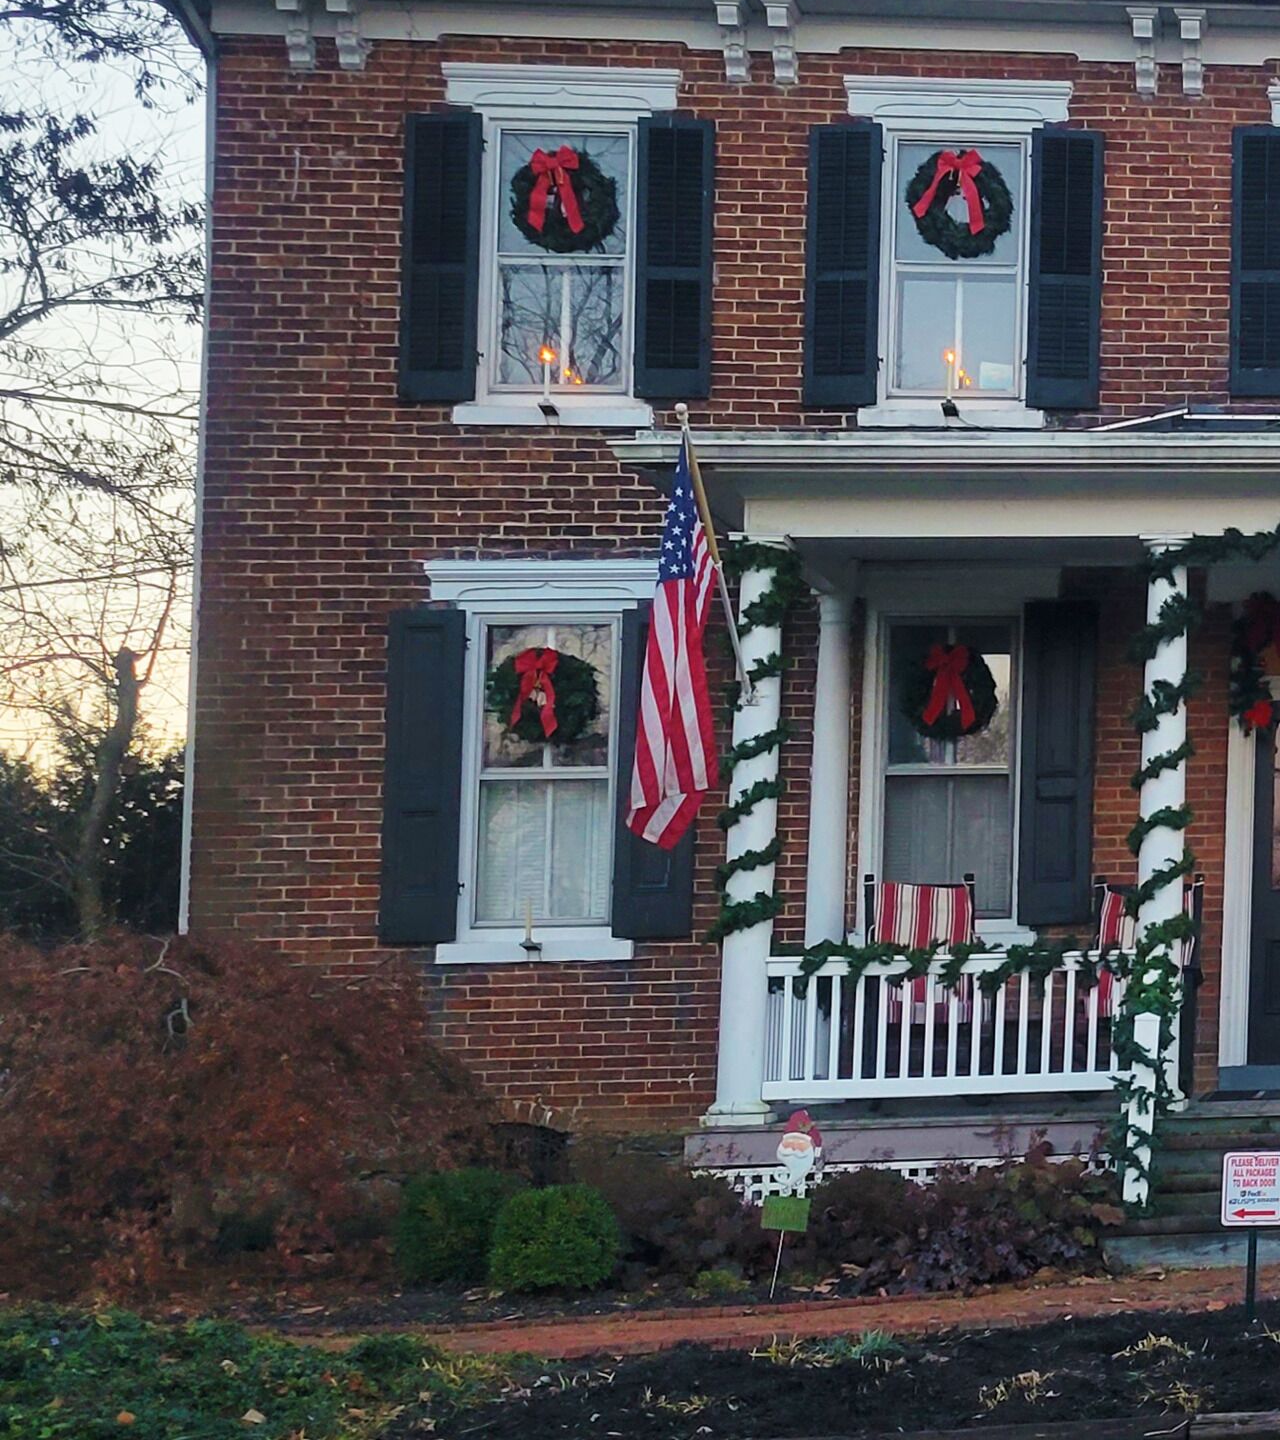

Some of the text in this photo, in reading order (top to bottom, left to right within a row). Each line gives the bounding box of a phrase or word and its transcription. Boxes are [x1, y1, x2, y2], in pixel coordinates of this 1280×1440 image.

[1231, 1158, 1279, 1167] PLEASE DELIVER
[1233, 1168, 1276, 1177] ALL PACKAGES
[1233, 1178, 1276, 1187] TO BACK DOOR
